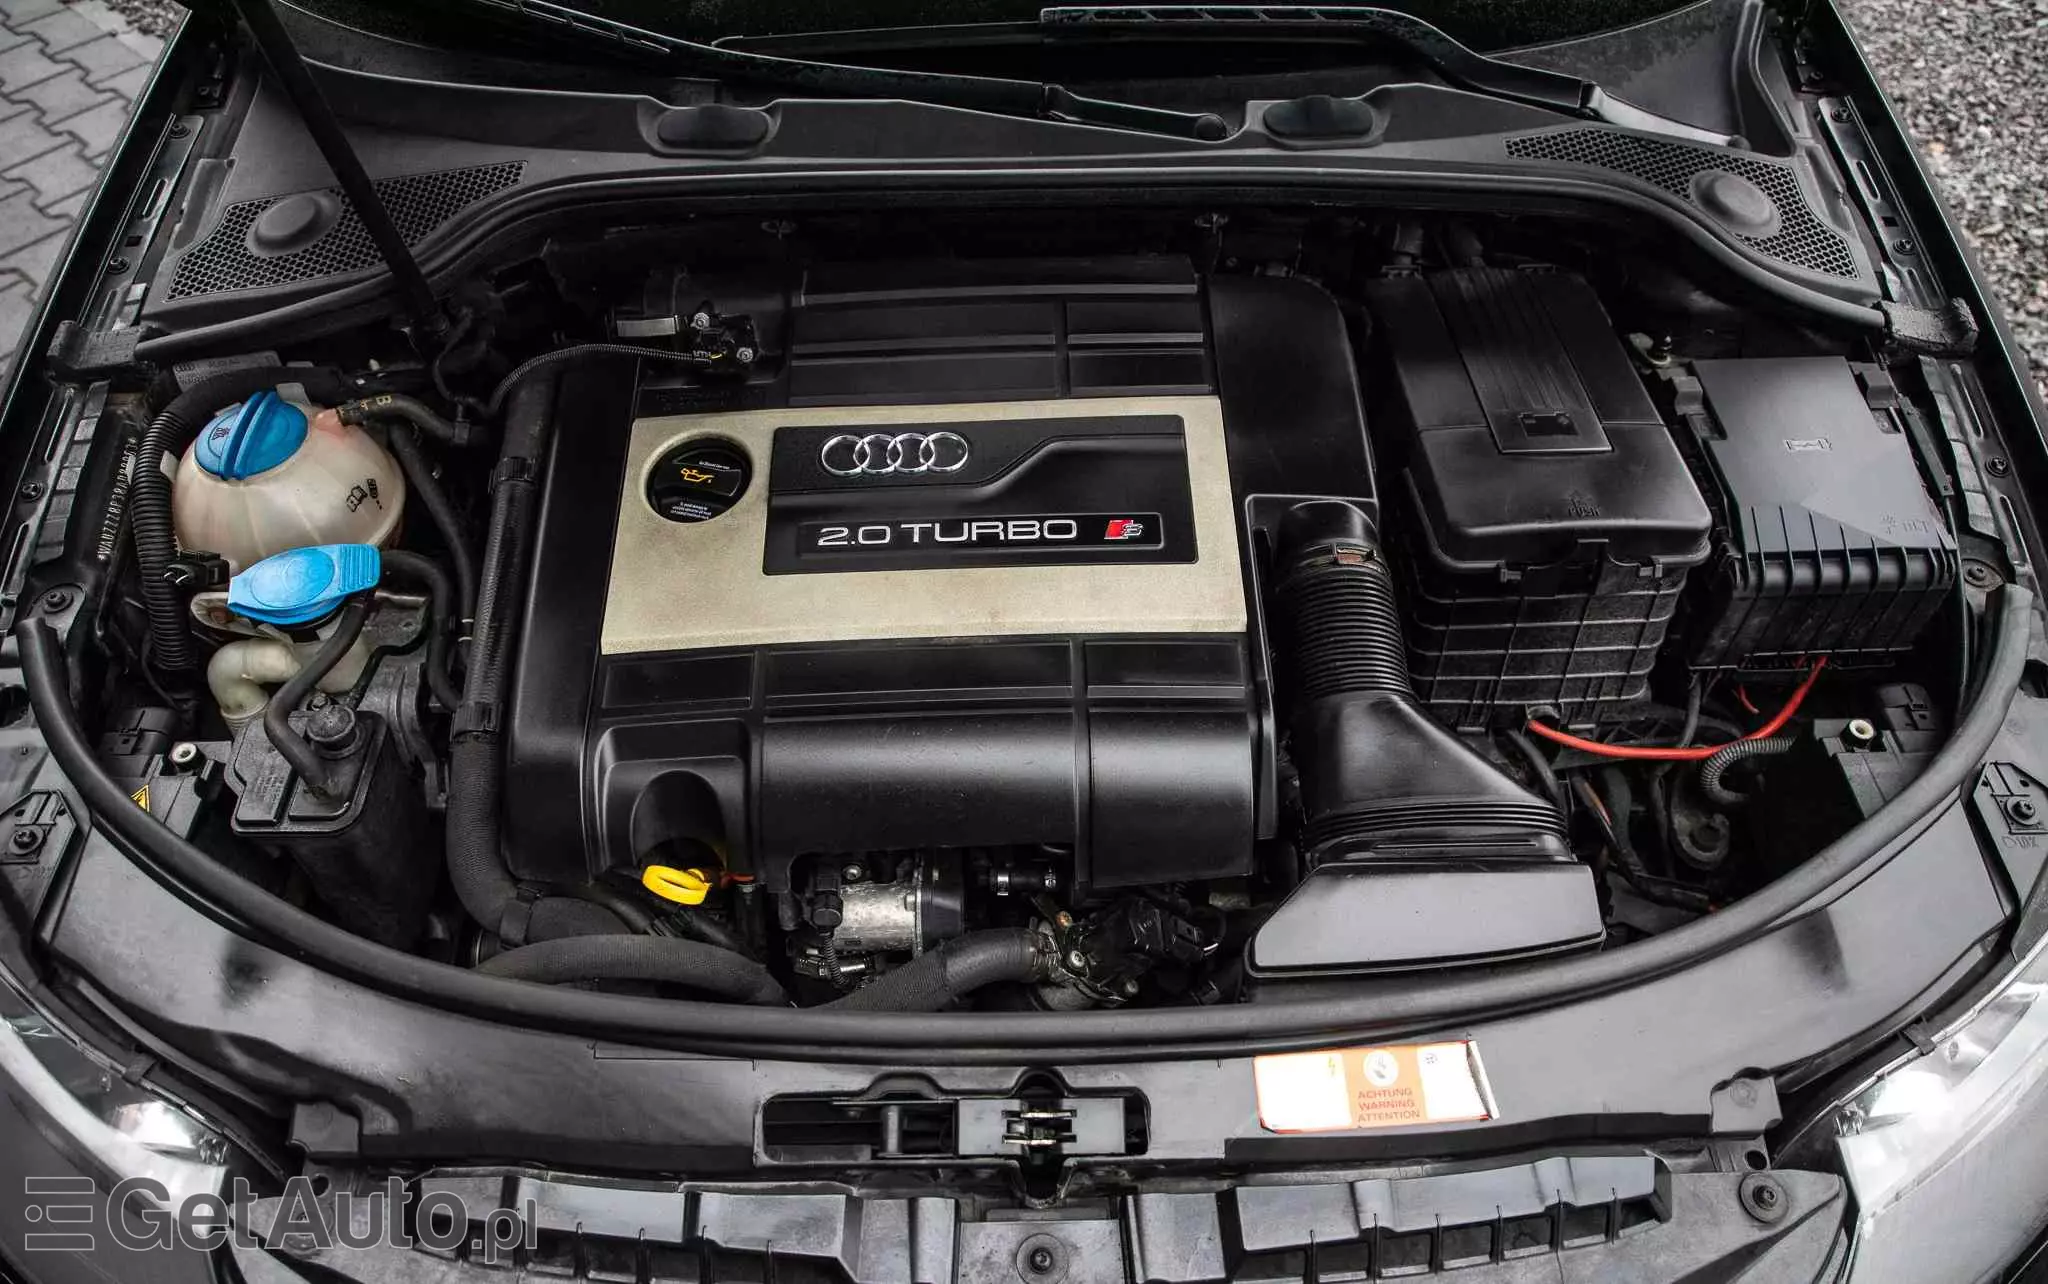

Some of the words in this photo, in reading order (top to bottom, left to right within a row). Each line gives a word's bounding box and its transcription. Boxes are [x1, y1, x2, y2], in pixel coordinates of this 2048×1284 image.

[817, 525, 891, 546] 2.0
[901, 519, 1078, 542] TURBO
[1358, 1087, 1412, 1099] ACHTUNG
[1358, 1099, 1415, 1111] WARNING
[1358, 1110, 1420, 1122] ATTENTION
